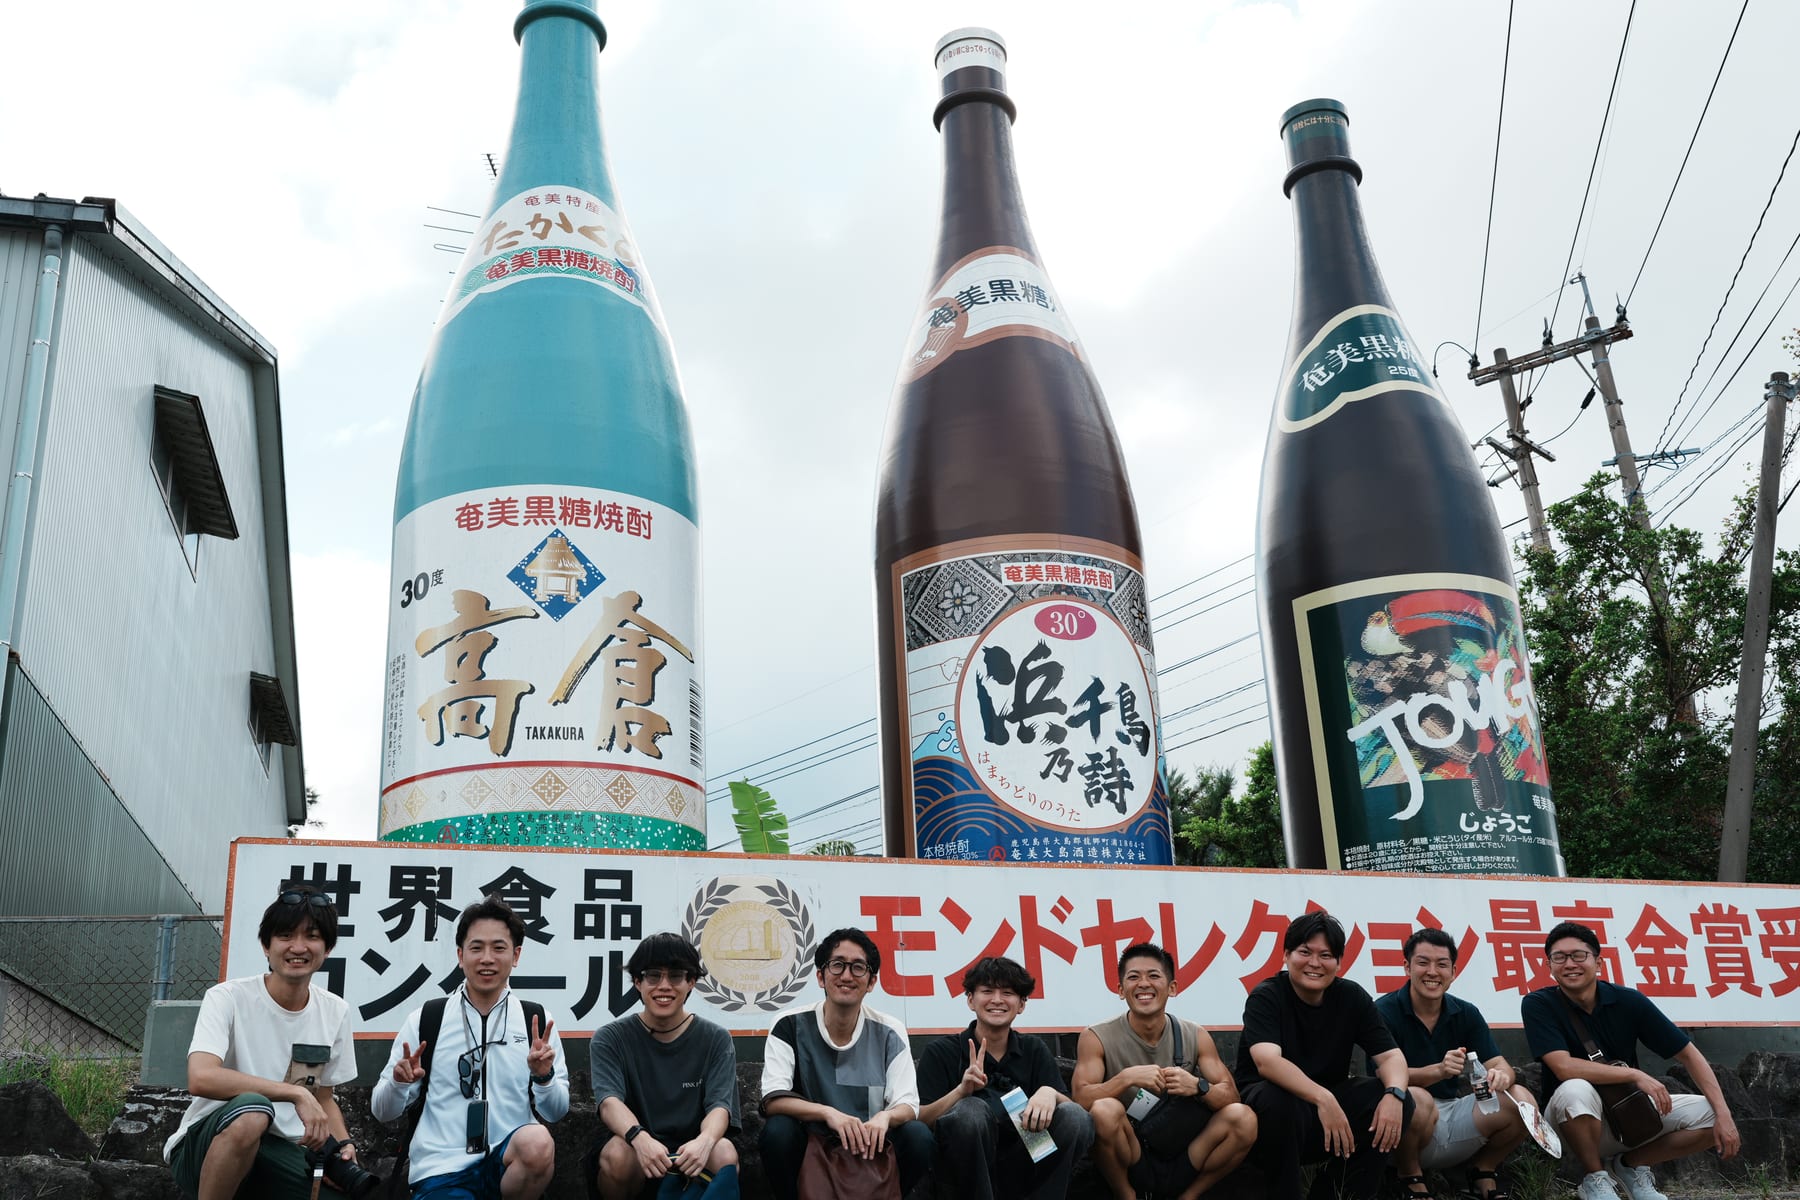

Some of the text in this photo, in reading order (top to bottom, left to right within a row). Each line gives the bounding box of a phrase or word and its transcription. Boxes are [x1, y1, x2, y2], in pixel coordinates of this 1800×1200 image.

[524, 193, 601, 215] 奄美特産
[485, 249, 635, 293] 奄美黒糖焼酎
[928, 279, 1057, 328] 奄美黒糖
[1299, 334, 1416, 392] 奄美黒糖
[455, 496, 653, 540] 奄美黒糖焼酎
[401, 569, 444, 608] 30度
[1004, 564, 1113, 589] 奄美黒糖焼酎
[1050, 611, 1086, 636] 30°
[415, 589, 694, 759] 高倉
[525, 726, 584, 741] TAKAKURA
[977, 752, 1081, 822] はまちどりのうた
[1460, 811, 1532, 833] じょうご
[923, 839, 969, 858] 本格焼酎
[1011, 847, 1147, 861] 奄美大島酒造株式会社
[280, 862, 643, 945] 世界食品
[312, 948, 642, 1021] ンール
